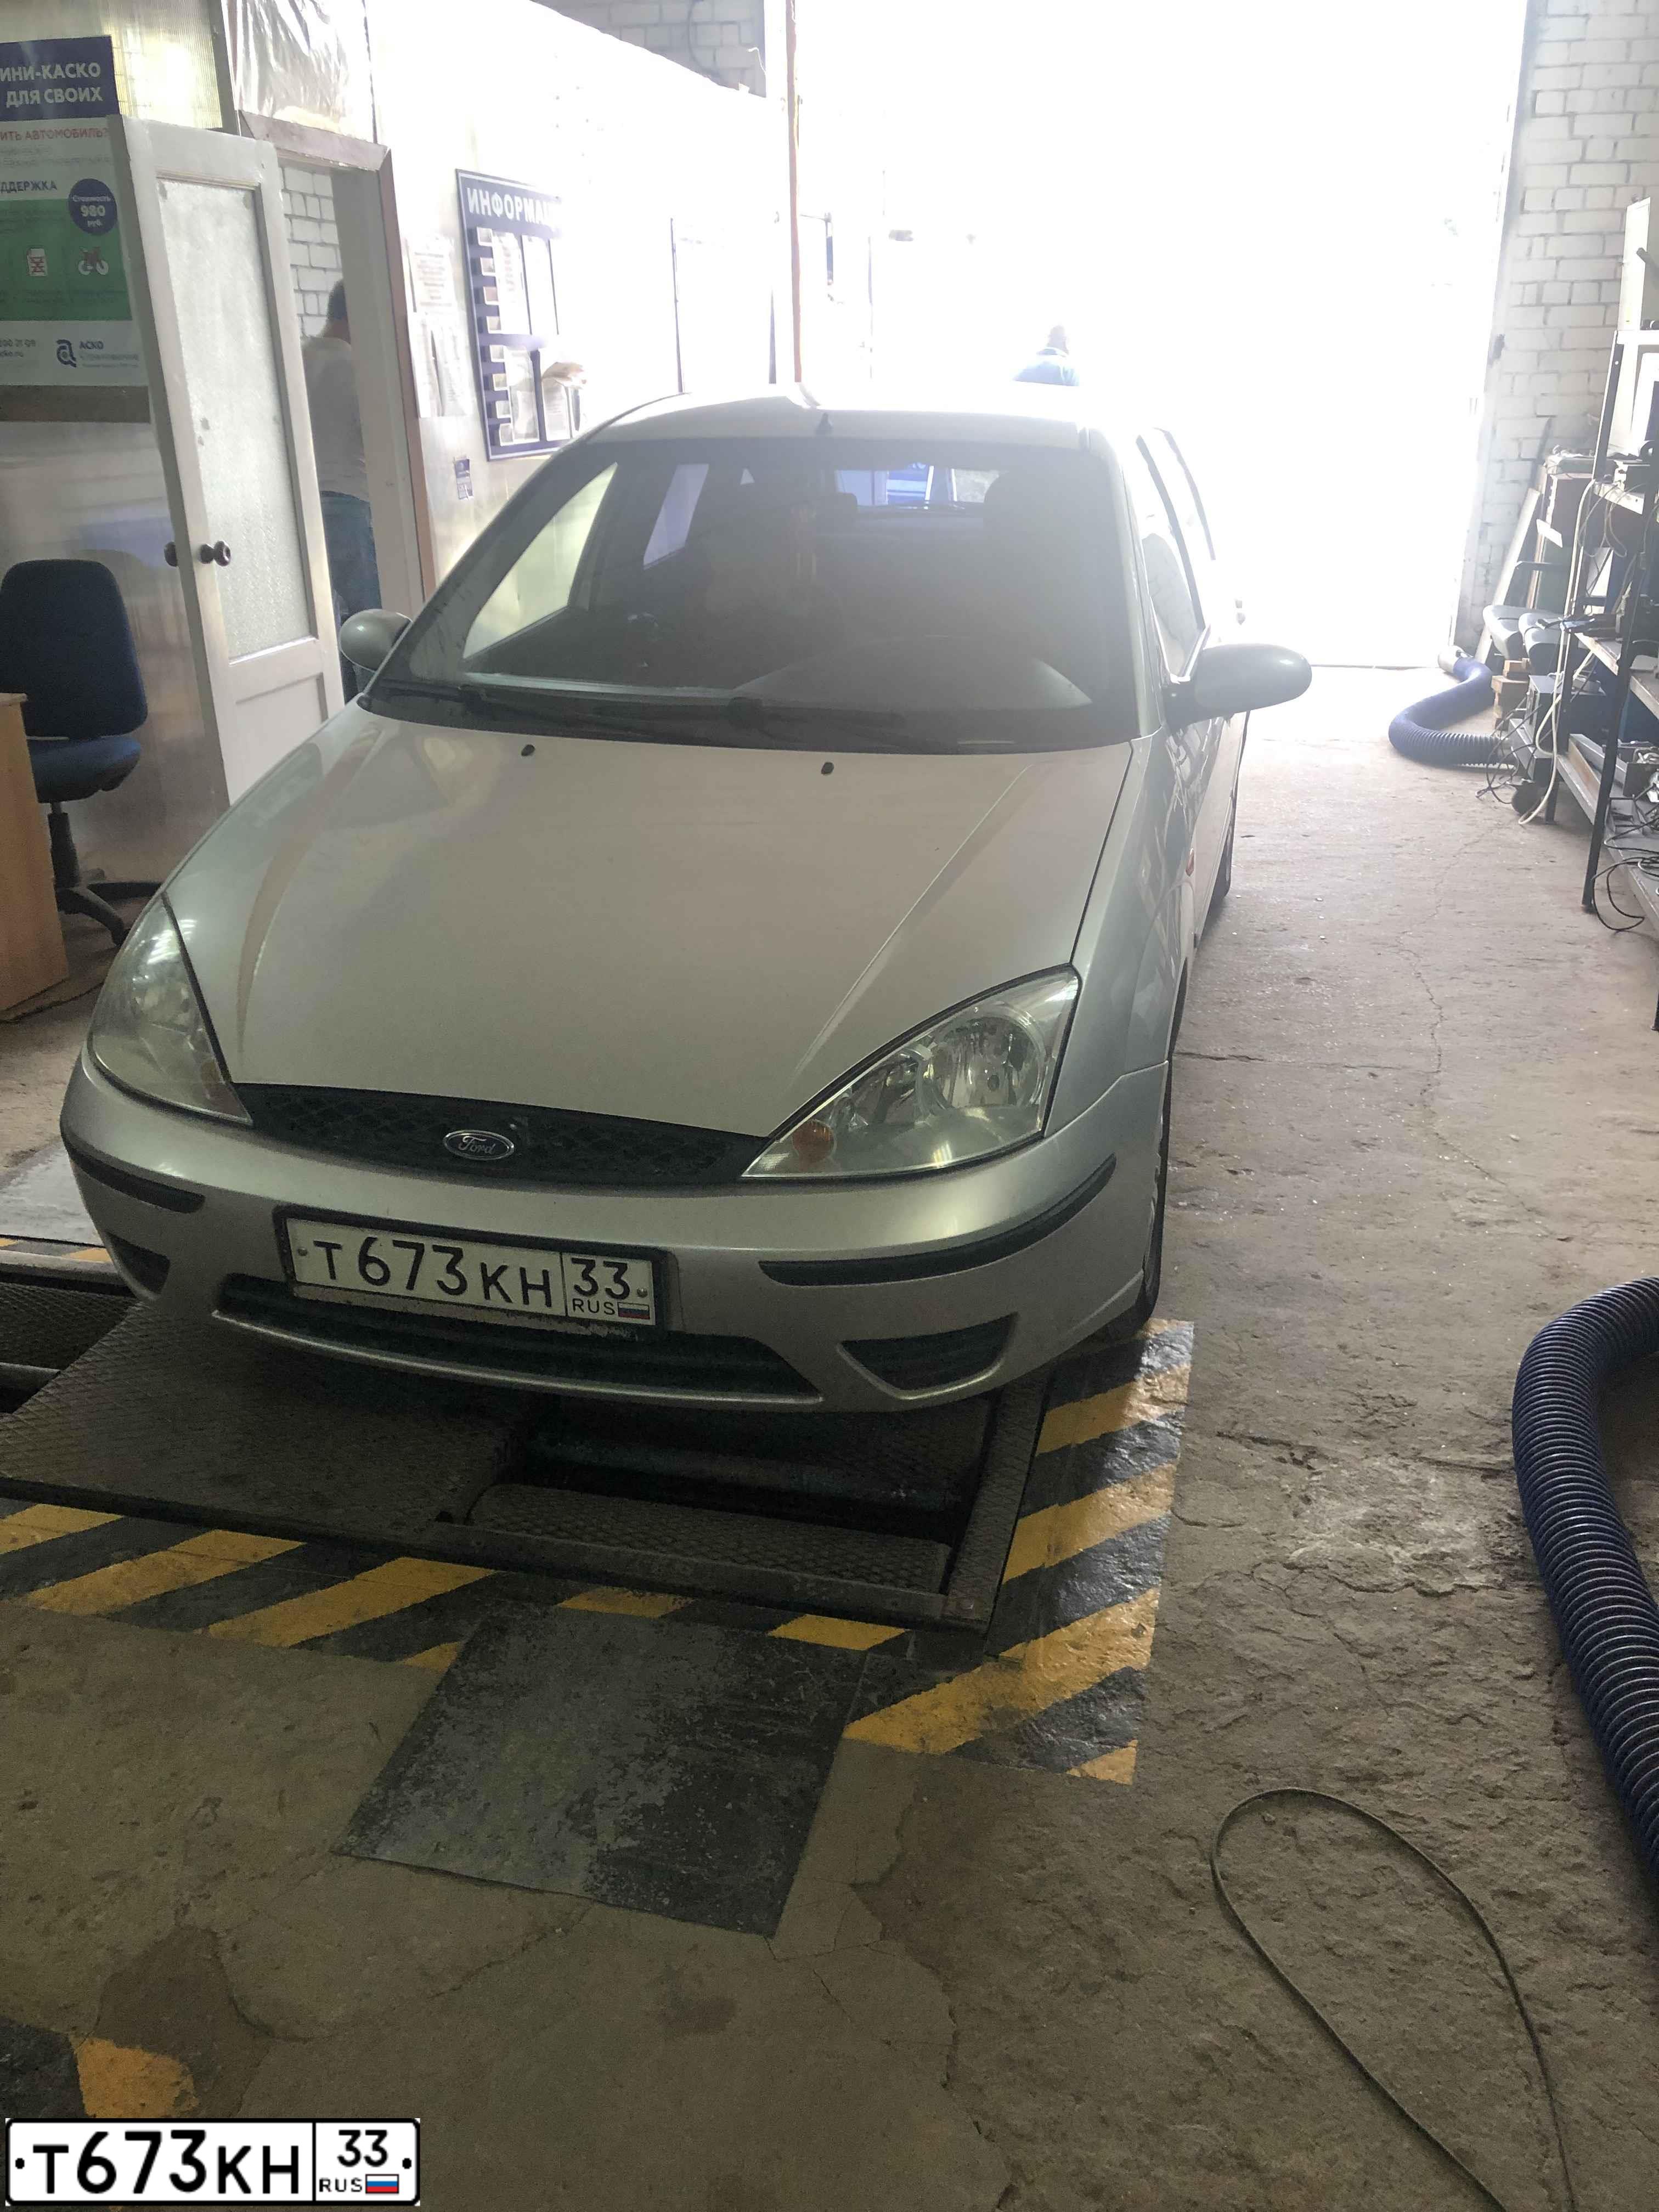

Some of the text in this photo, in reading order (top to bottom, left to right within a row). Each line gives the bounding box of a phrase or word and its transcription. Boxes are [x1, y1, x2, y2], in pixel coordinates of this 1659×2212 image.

[6, 87, 103, 108] ДЛЯ СВОИХ
[81, 205, 105, 217] 980
[80, 341, 104, 349] АСКО
[458, 1136, 496, 1154] Ford
[313, 1237, 631, 1308] Т673КН 33
[573, 1298, 616, 1316] RUS
